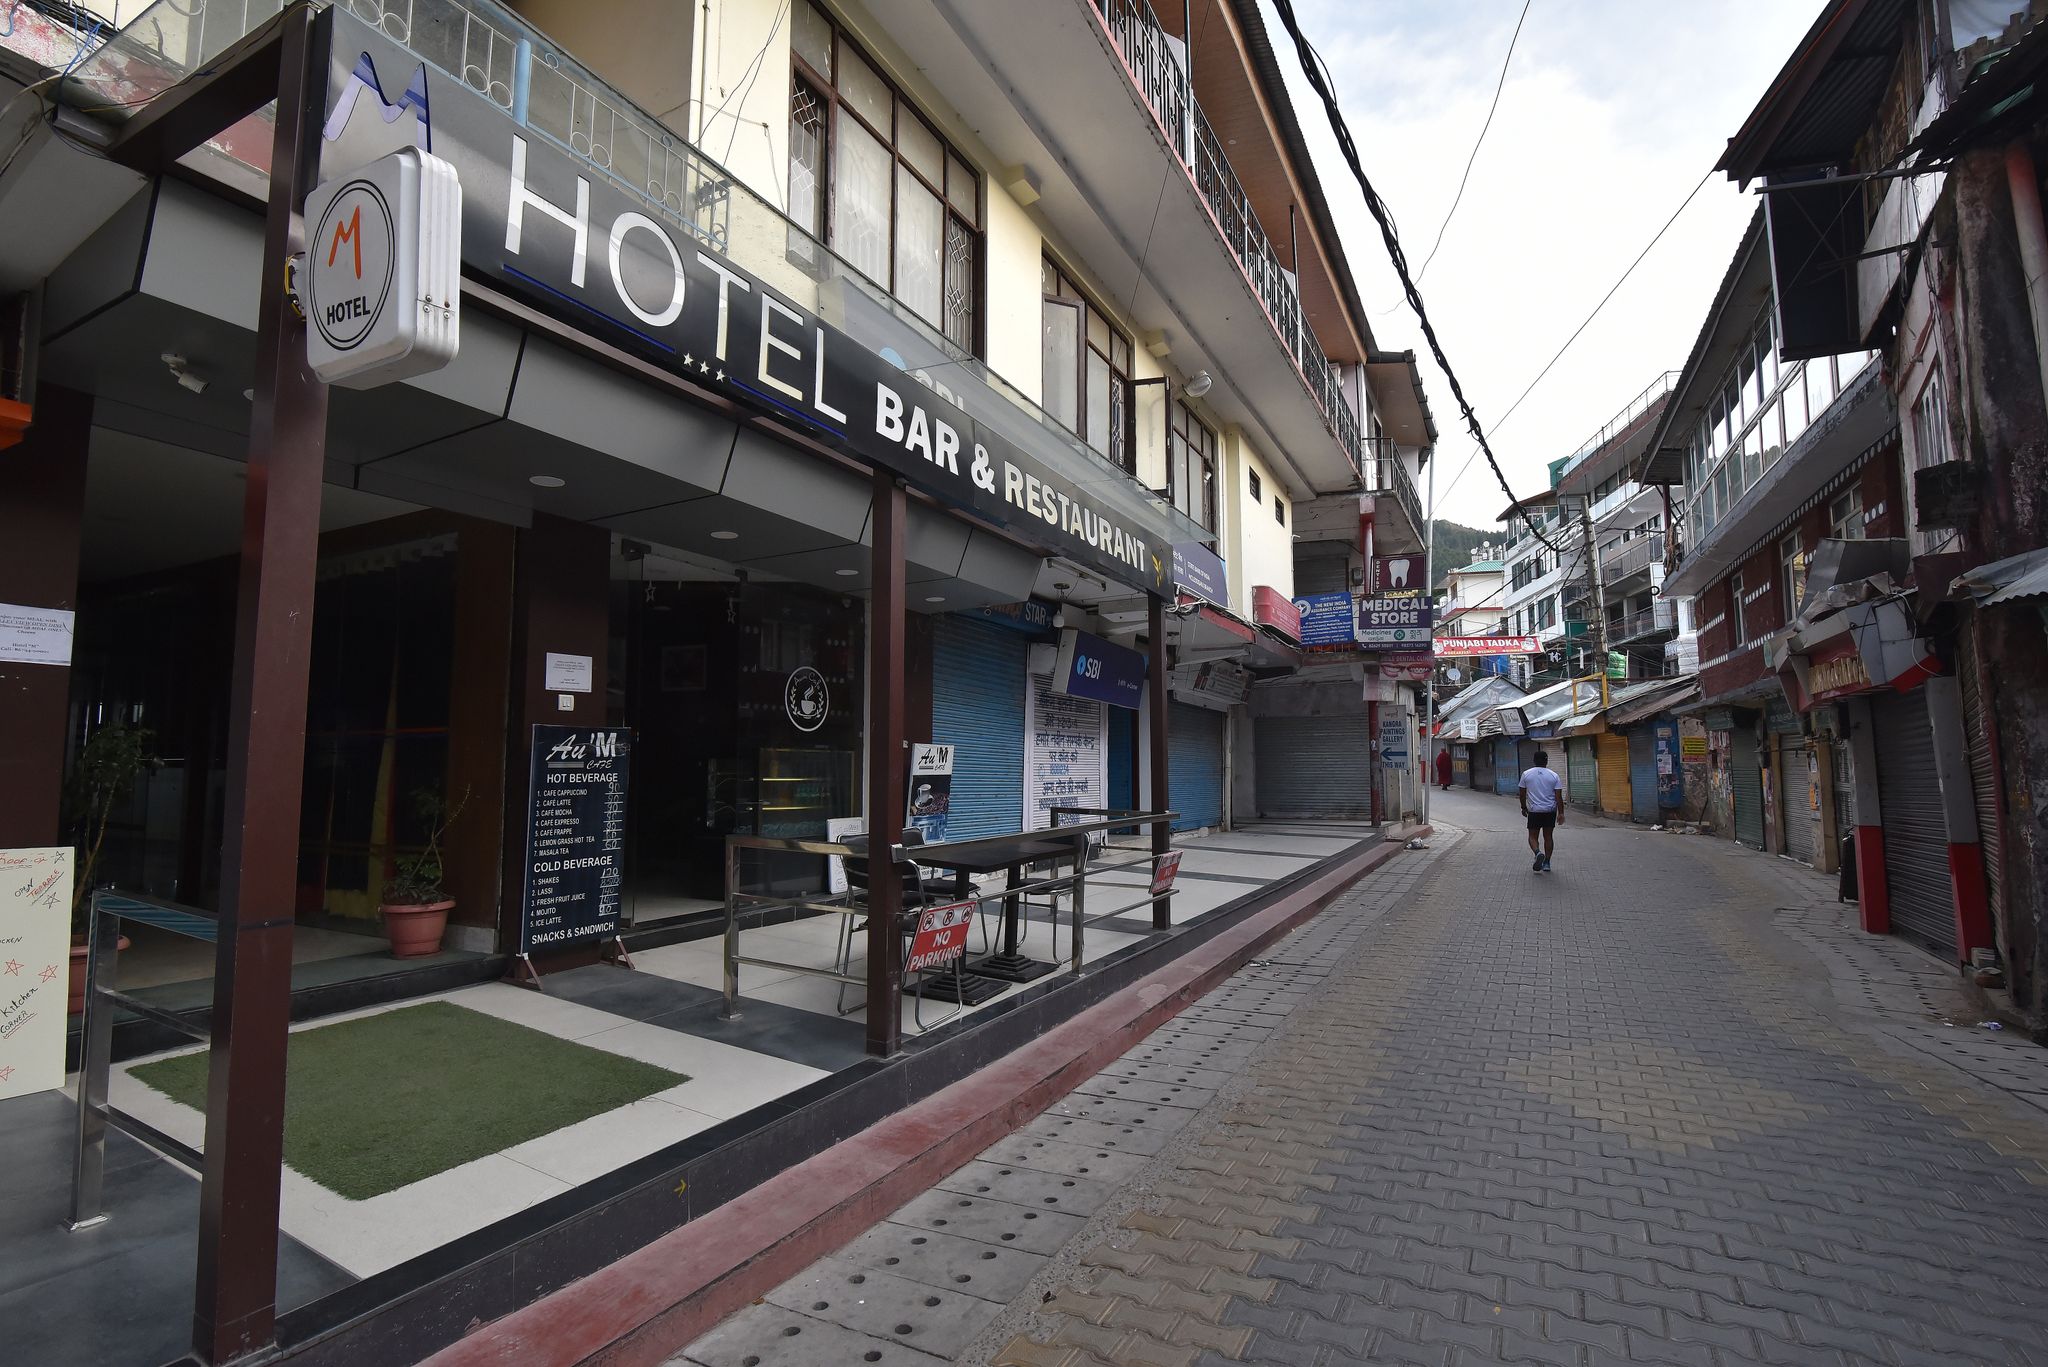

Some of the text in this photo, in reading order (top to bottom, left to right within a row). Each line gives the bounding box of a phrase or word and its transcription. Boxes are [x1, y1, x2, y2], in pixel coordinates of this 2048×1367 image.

[328, 204, 362, 280] M
[505, 133, 847, 425] HOTEL
[327, 296, 371, 326] HOTEL
[876, 382, 960, 476] BAR
[971, 443, 995, 494] &
[1005, 461, 1146, 572] RESTAURANT
[1362, 598, 1429, 612] MEDICAL
[1025, 602, 1046, 625] STAR
[1370, 611, 1418, 625] STORE
[1443, 639, 1520, 649] PUNJABI TADKA
[1085, 657, 1102, 680] SBI
[1382, 735, 1404, 743] GALLERY
[1382, 761, 1406, 769] THIS WAY
[546, 772, 619, 784] HOT BEVERAGE
[557, 788, 588, 797] CAPPUCCINO
[556, 799, 572, 807] LATTE
[554, 809, 573, 817] MOCHA
[554, 818, 580, 826] EXPRESSO
[539, 839, 557, 847] LEMON
[557, 838, 574, 846] GRASS
[574, 836, 584, 844] HOT
[586, 835, 596, 843] TEA
[538, 848, 560, 857] MASALA
[560, 847, 570, 855] TEA
[533, 855, 614, 873] COLD BEVERAGE
[537, 876, 560, 886] SHAKES
[537, 887, 553, 896] LASSI
[536, 898, 555, 906] FRESH
[555, 895, 571, 904] FRUIT
[571, 892, 586, 901] JUICE
[535, 907, 557, 916] MOJITO
[535, 918, 545, 927] ICE
[545, 915, 562, 925] LATTE
[531, 921, 614, 944] SNACKS & SANDWICH
[932, 929, 952, 948] NO
[908, 944, 962, 972] PARKING
[0, 986, 39, 1018] Kitchen
[0, 1010, 29, 1034] CORNER
